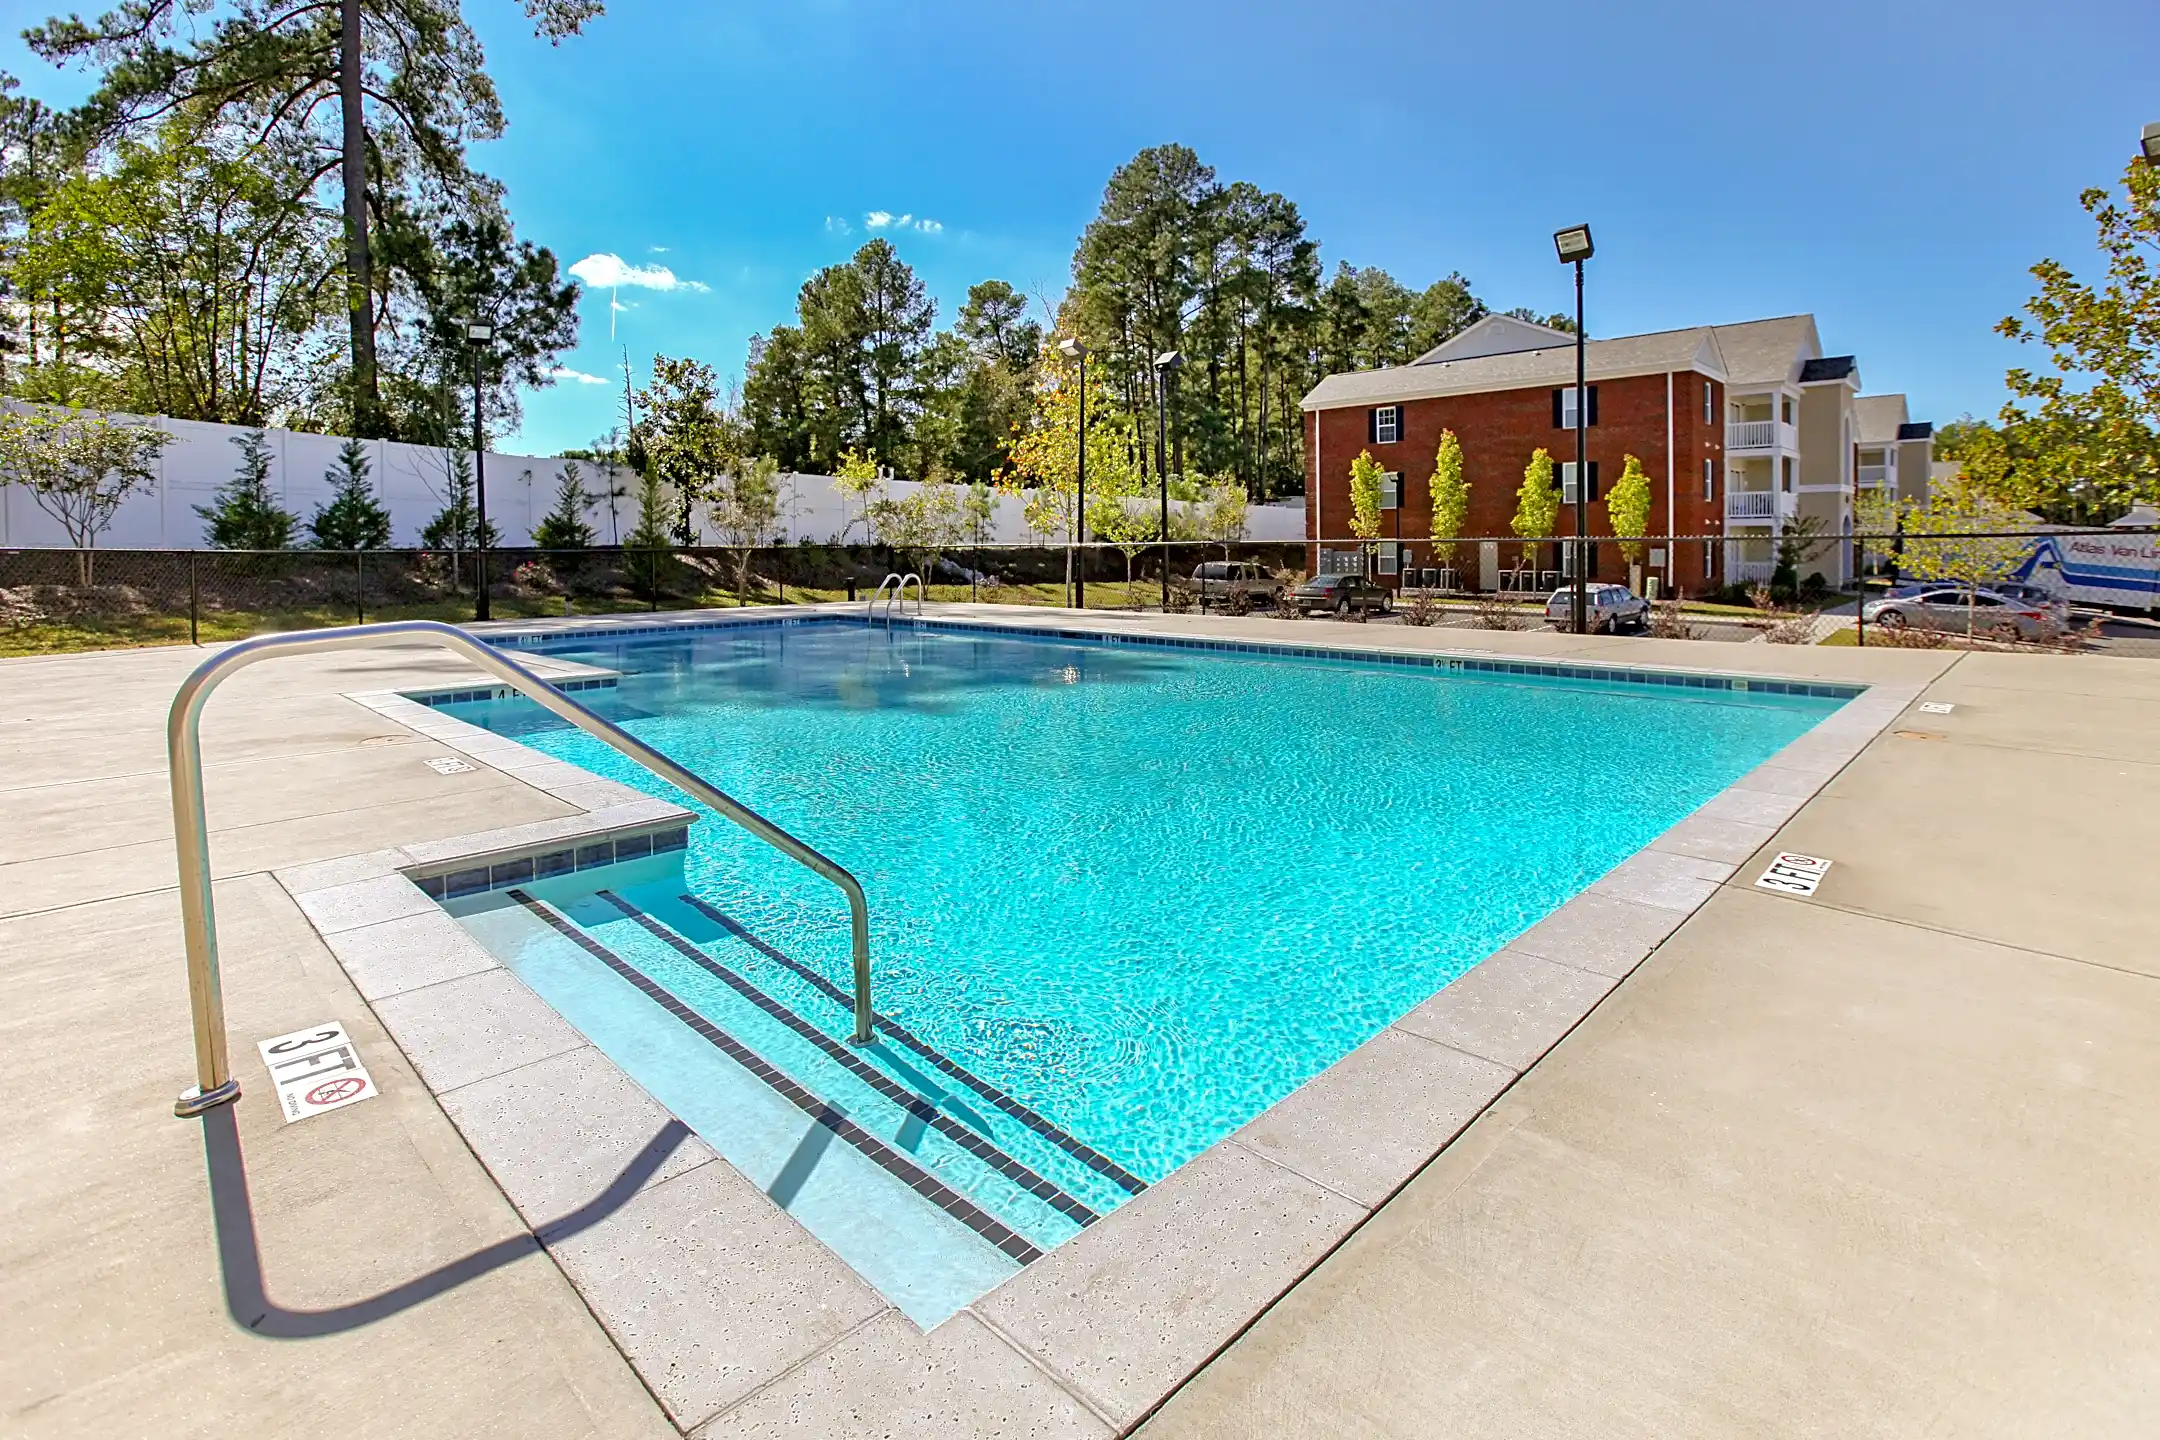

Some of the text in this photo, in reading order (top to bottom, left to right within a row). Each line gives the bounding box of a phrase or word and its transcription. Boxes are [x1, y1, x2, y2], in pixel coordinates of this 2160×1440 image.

[2069, 541, 2106, 555] Atlas
[2111, 544, 2138, 558] Van
[1763, 863, 1820, 890] 3 FT
[268, 1031, 356, 1086] 3 FT
